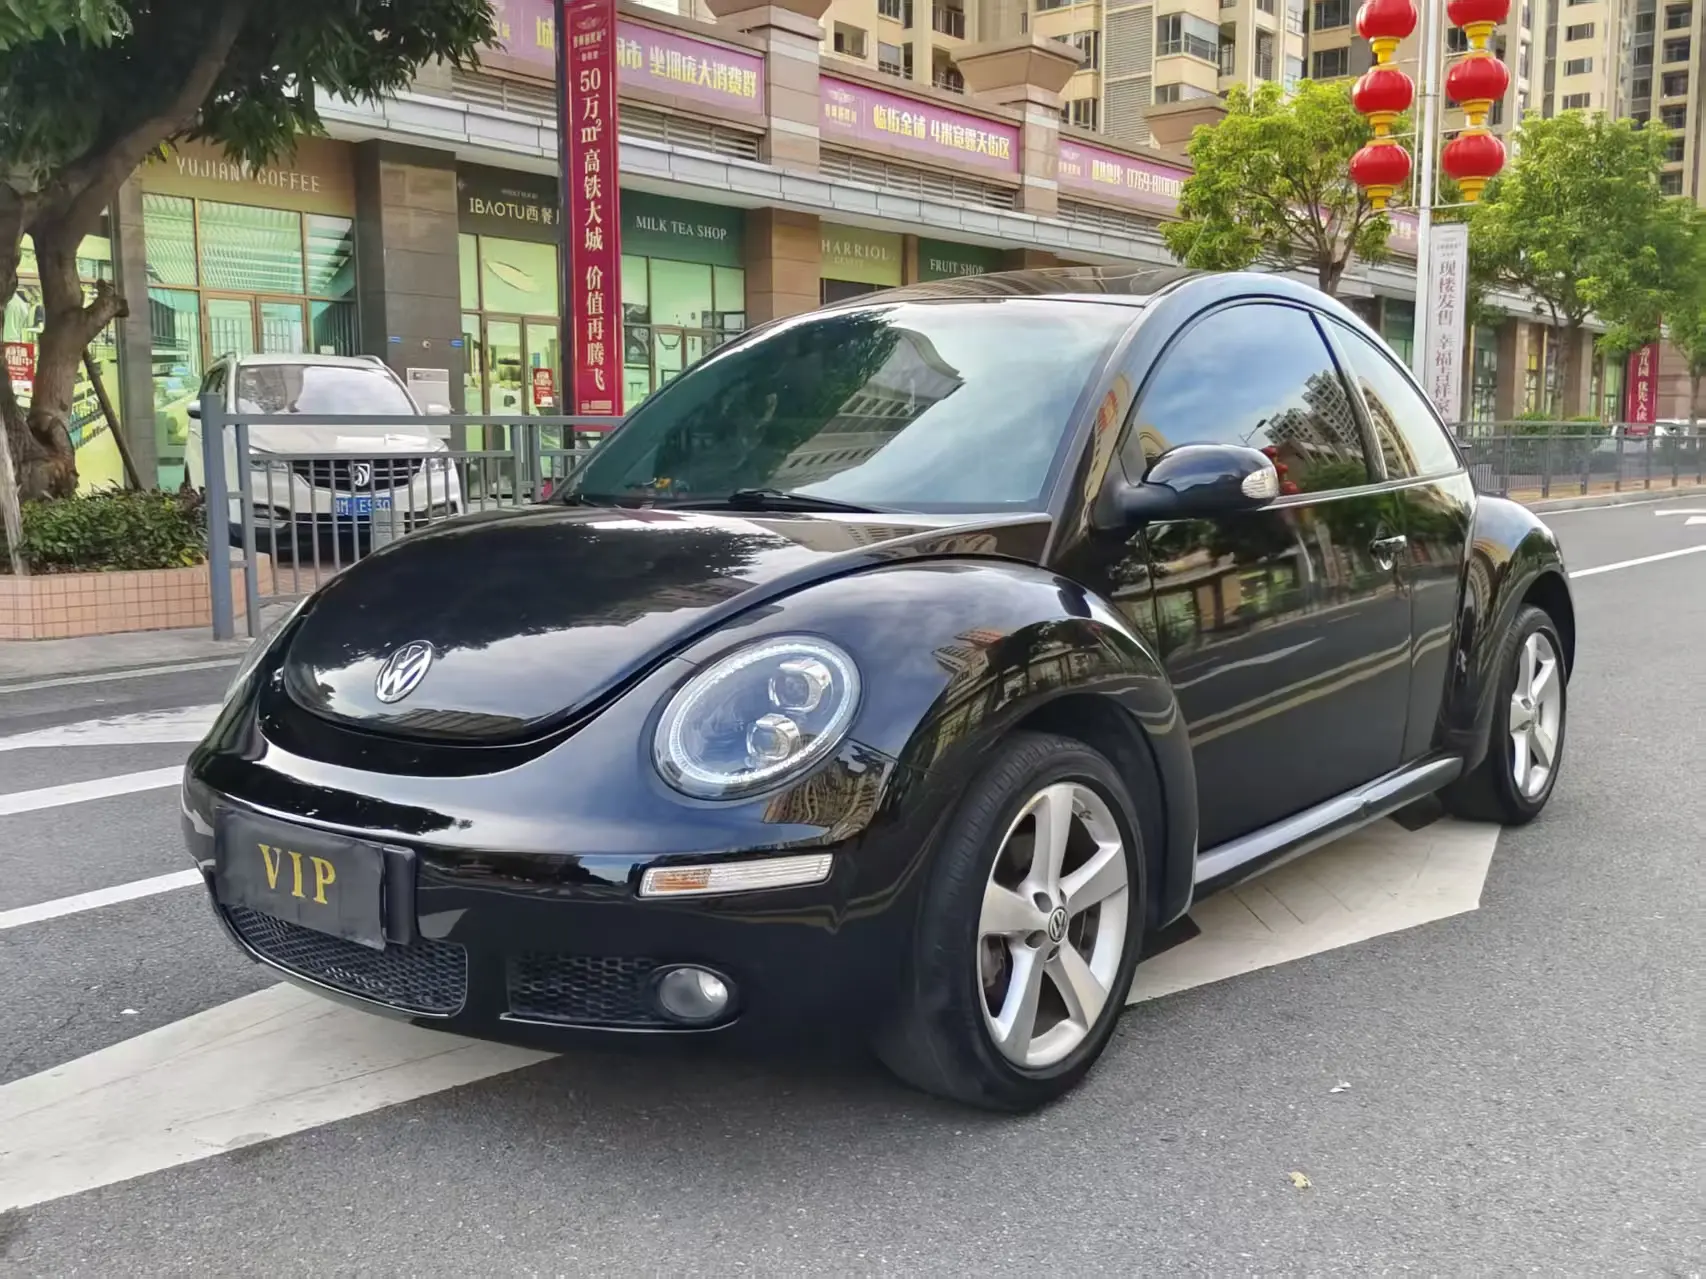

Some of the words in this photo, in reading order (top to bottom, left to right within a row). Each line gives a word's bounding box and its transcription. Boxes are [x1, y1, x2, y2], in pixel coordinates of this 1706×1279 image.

[176, 155, 240, 182] YUJIAN
[256, 166, 320, 193] COFFEE
[469, 197, 560, 225] IBAOTU西餐
[636, 215, 667, 232] MILK
[670, 220, 694, 236] TEA
[696, 224, 727, 240] SHOP
[929, 258, 958, 274] FRUIT
[585, 265, 606, 391] 价值再腾飞
[258, 843, 337, 905] VIP
